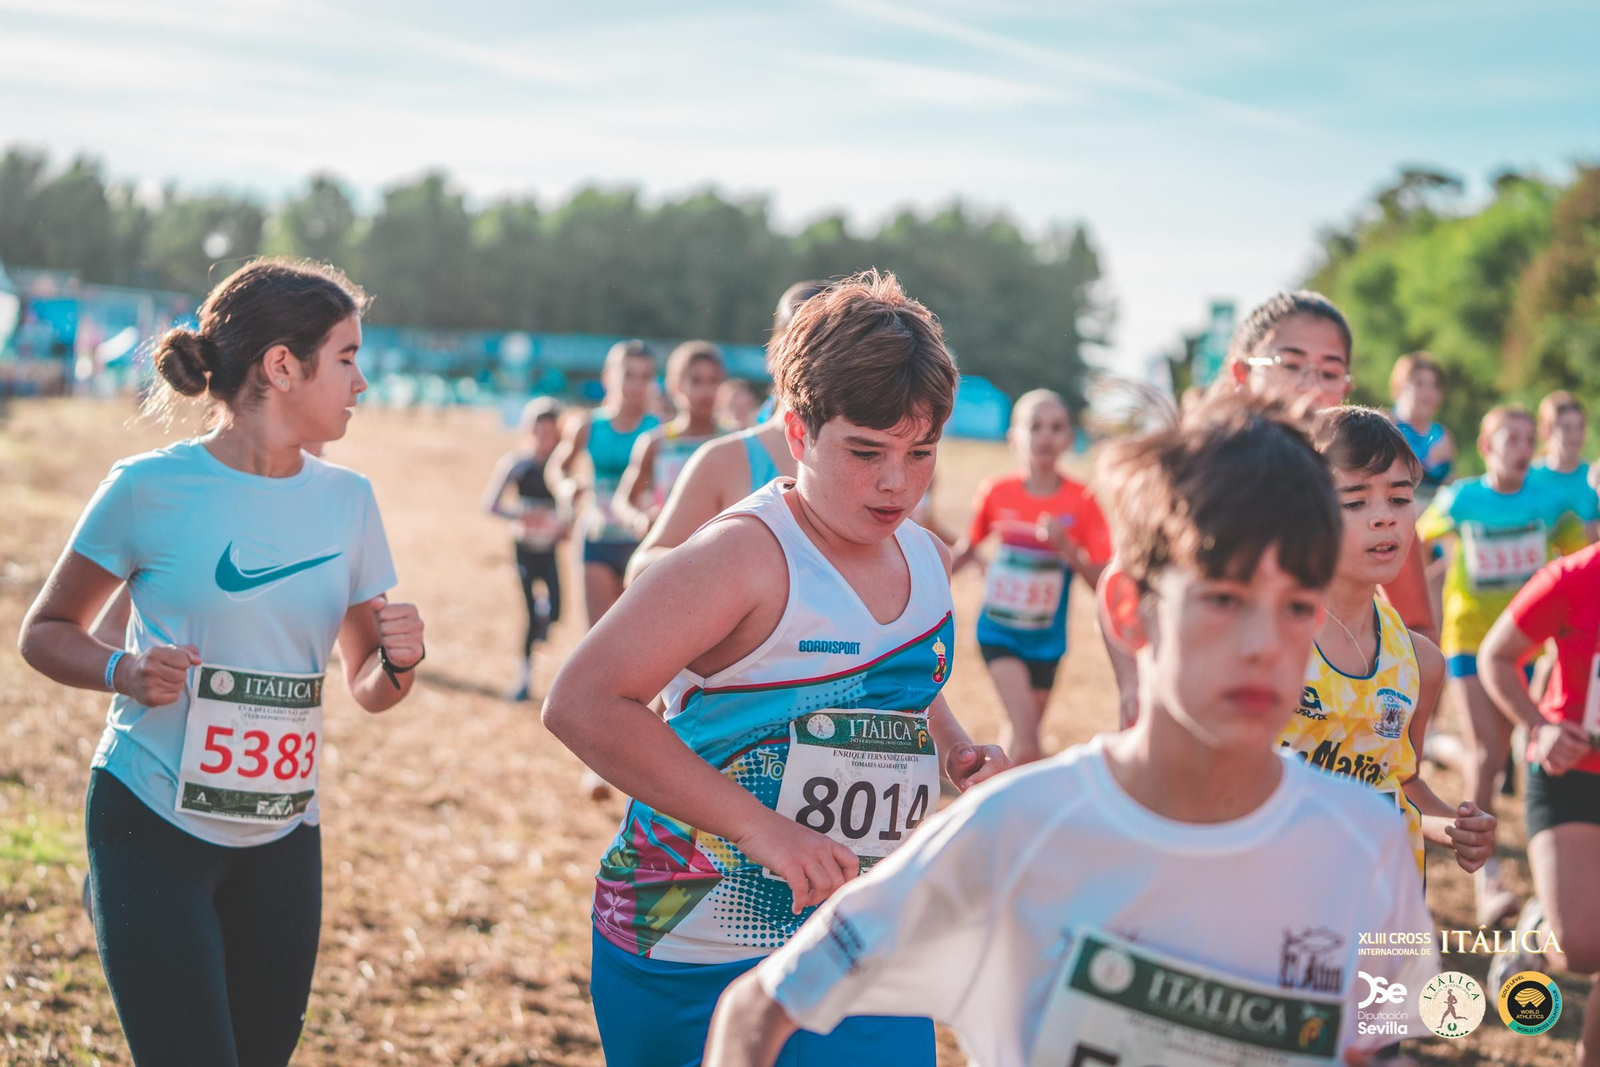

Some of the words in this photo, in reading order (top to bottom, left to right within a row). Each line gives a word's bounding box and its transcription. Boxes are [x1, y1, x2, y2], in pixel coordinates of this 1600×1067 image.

[799, 640, 861, 655] BORDISPORT
[245, 676, 312, 699] ITÁLICA
[849, 715, 912, 740] ITÁLICA
[199, 725, 316, 781] 5383
[833, 750, 866, 760] ENRIQUE
[867, 753, 899, 762] FERNANDEZ
[796, 776, 929, 841] 8014
